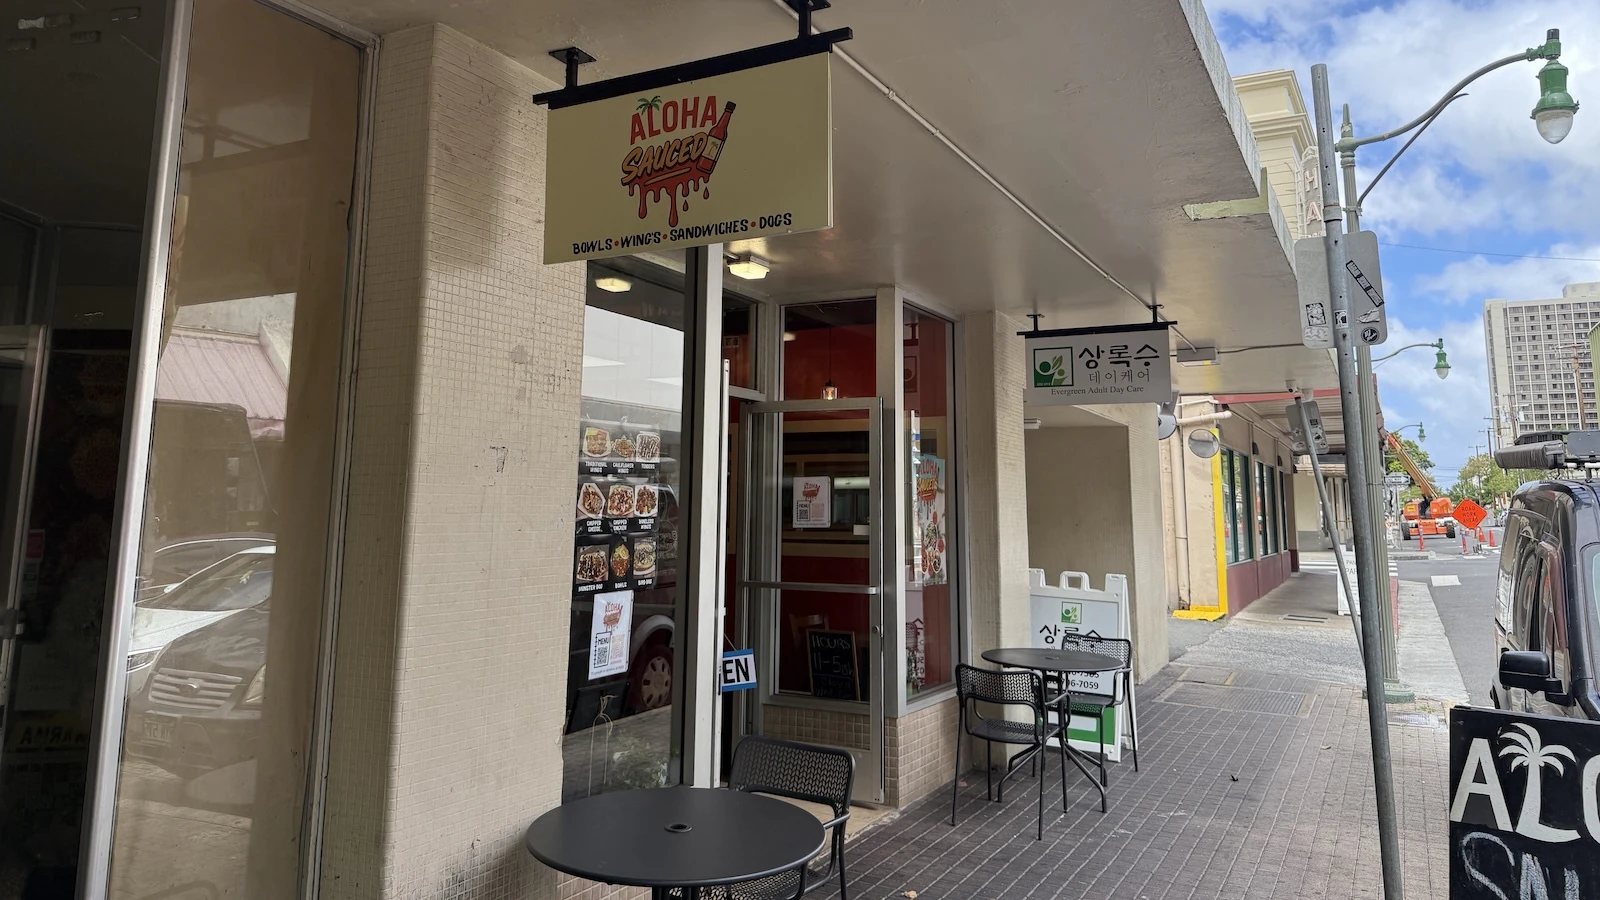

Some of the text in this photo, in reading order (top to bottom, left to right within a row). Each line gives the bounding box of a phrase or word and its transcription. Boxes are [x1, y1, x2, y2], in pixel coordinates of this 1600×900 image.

[630, 96, 717, 145] ALOHA
[620, 131, 709, 185] SAUCED
[572, 212, 793, 255] BOWLS WING'S SANDWICHES DOGS
[1051, 385, 1144, 396] Evergreen Adult Day Care
[811, 634, 851, 650] HOURS
